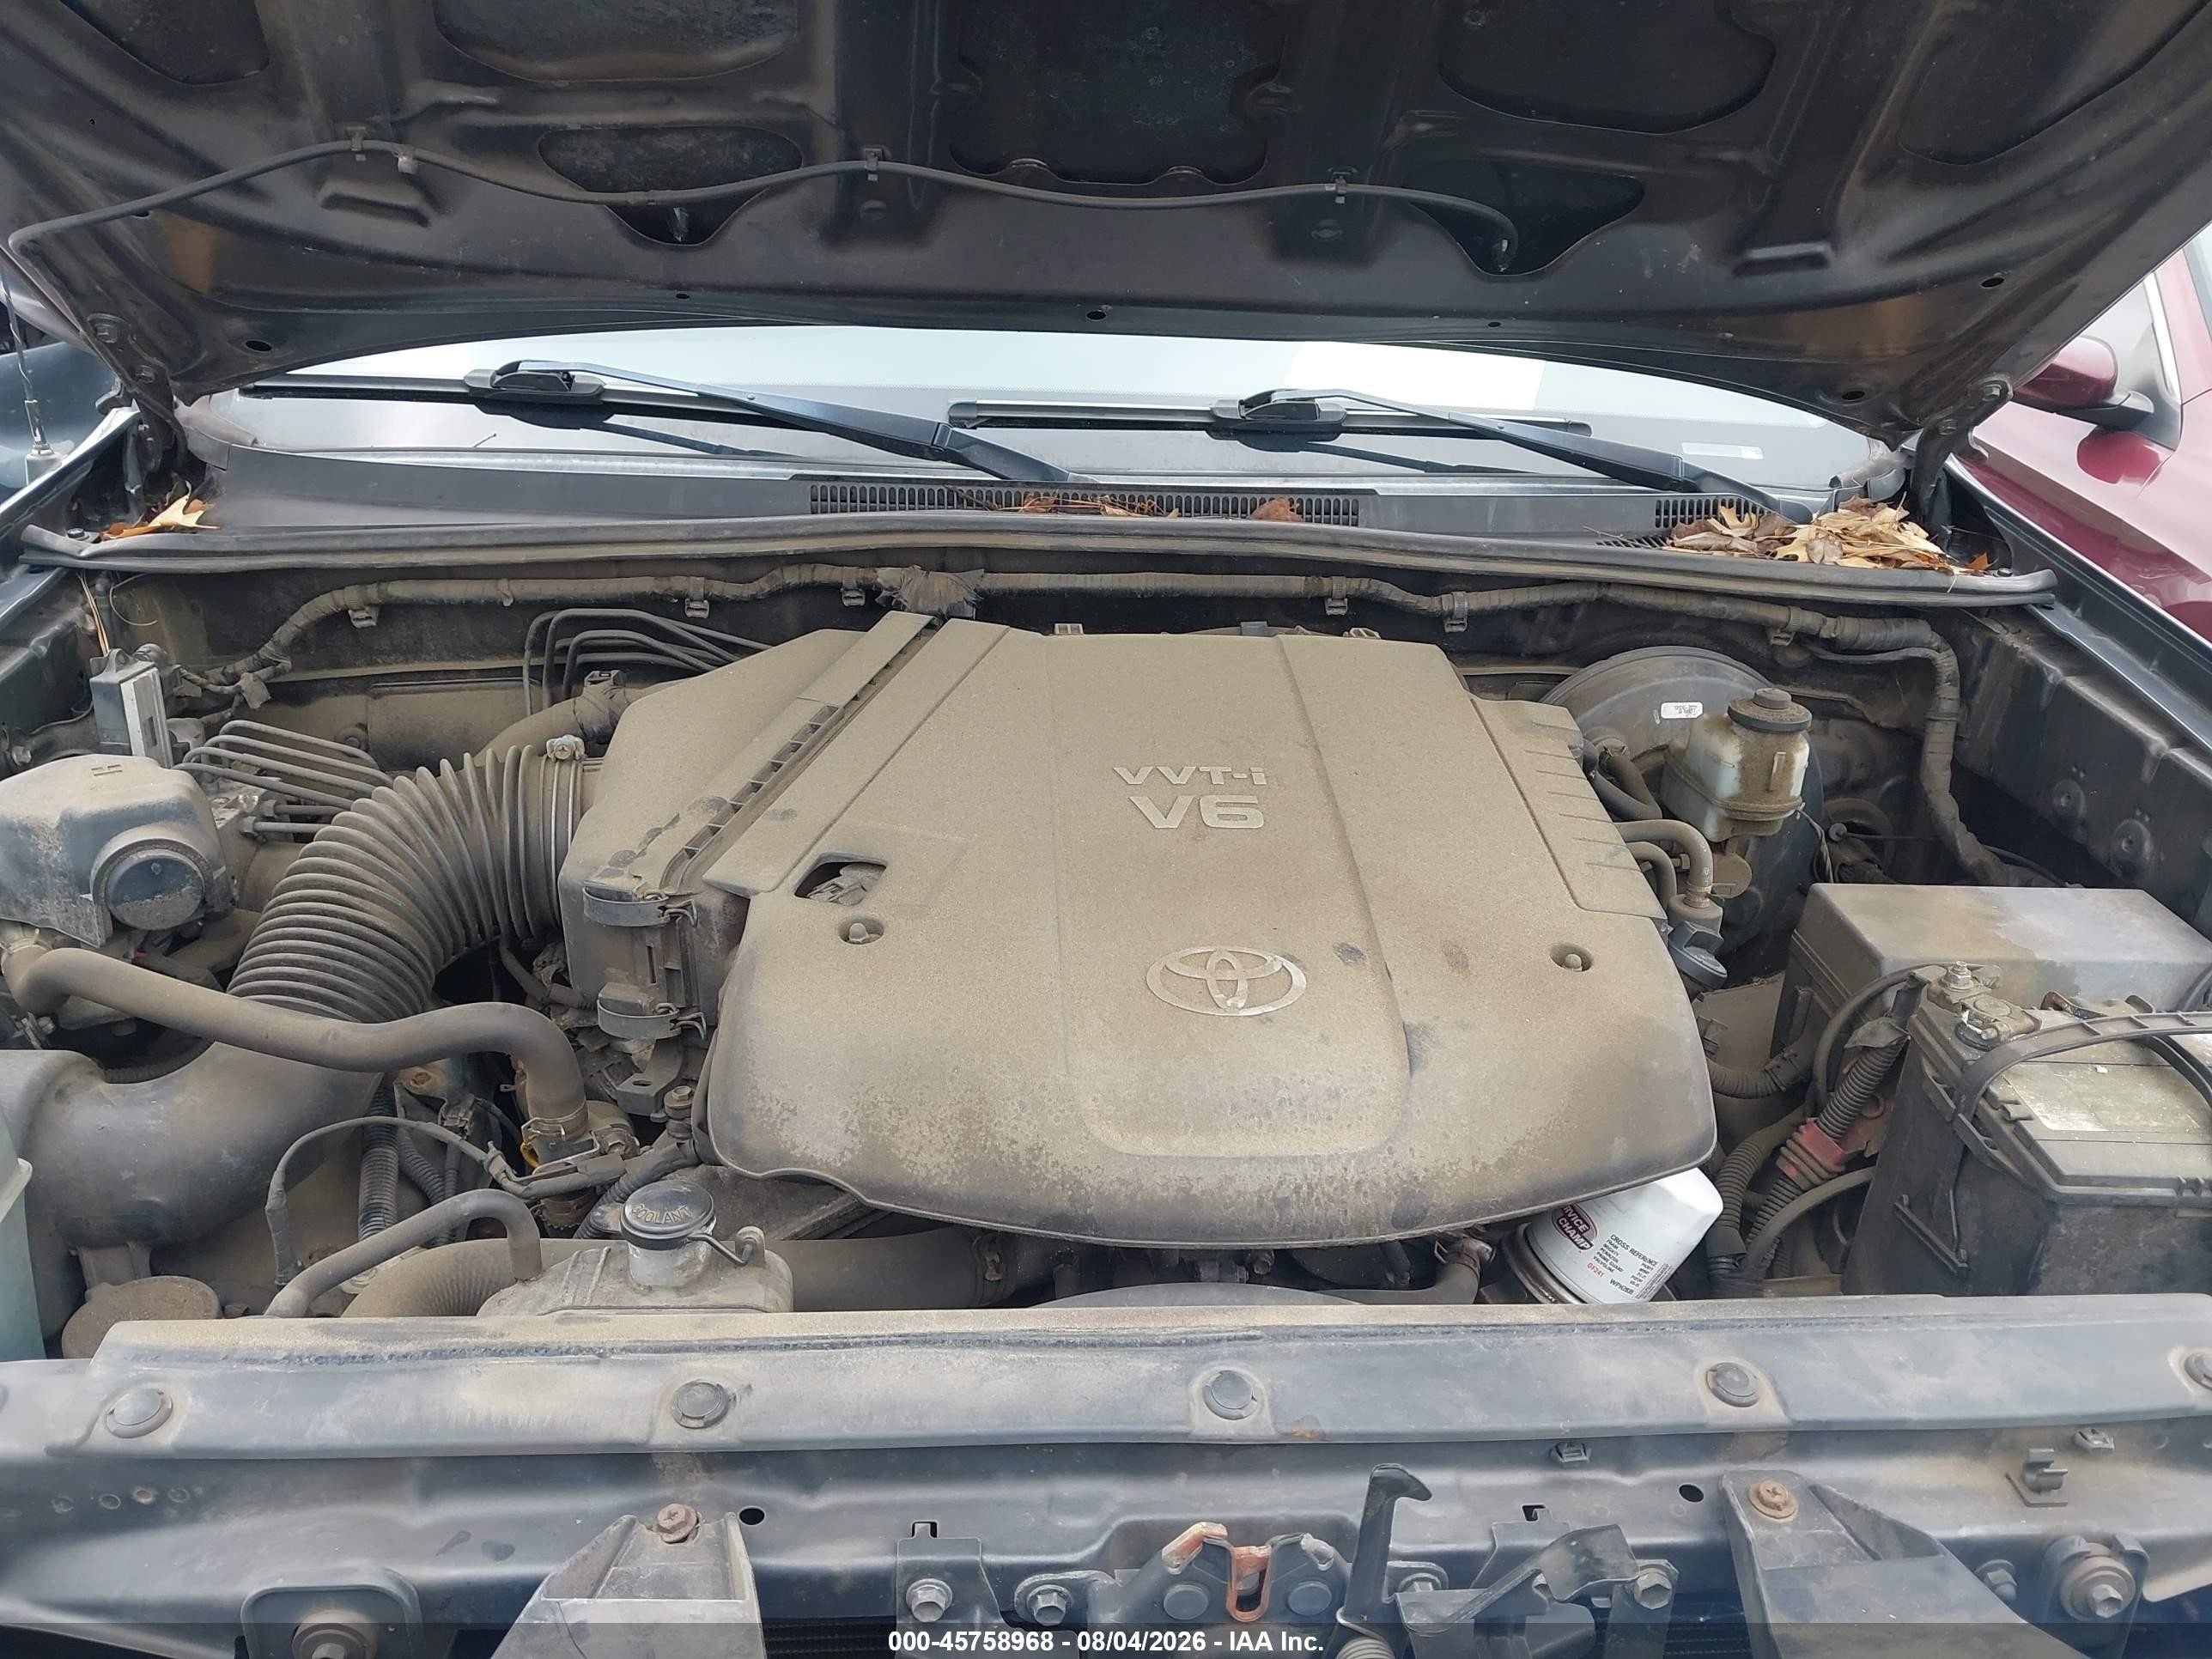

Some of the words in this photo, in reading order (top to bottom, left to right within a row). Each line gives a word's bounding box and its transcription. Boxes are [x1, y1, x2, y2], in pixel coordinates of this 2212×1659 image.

[1112, 766, 1267, 785] VVT-i
[1127, 794, 1265, 829] V6
[632, 1203, 694, 1224] COOLANT
[1559, 1217, 1591, 1249] CHAMP
[1602, 1243, 1620, 1256] MIGHTY
[1607, 1238, 1619, 1250] FRAM
[1610, 1233, 1631, 1250] CROSS
[1629, 1248, 1658, 1267] REFERENCE
[1593, 1255, 1614, 1273] VALVOLINE
[1596, 1251, 1610, 1263] PRIME
